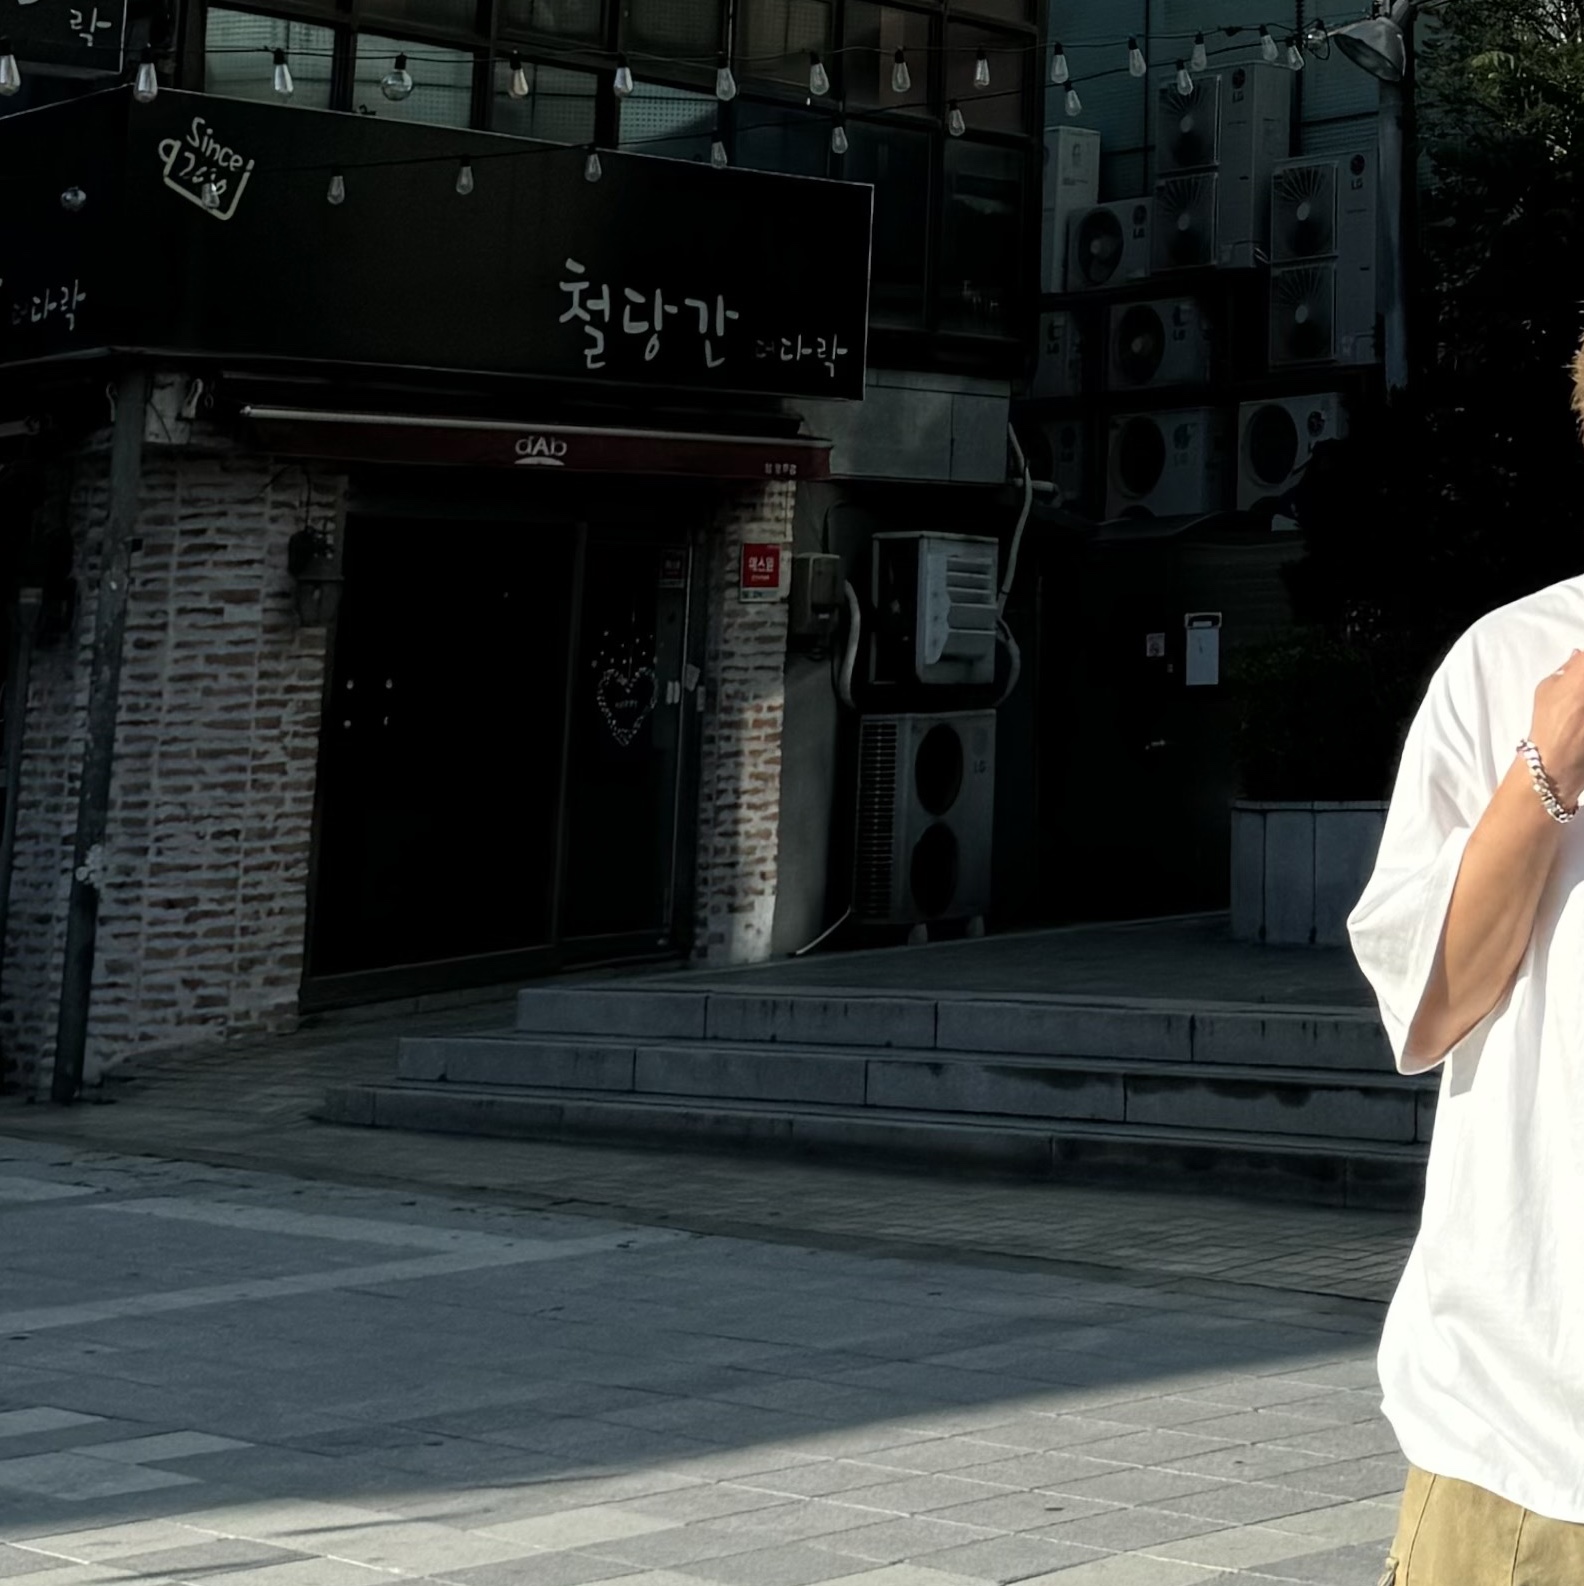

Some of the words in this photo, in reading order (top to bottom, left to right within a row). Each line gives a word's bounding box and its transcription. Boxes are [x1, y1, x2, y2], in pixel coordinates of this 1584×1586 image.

[186, 116, 243, 171] Since
[1351, 179, 1363, 190] LG
[1133, 228, 1145, 239] LG
[558, 257, 740, 370] 철당간
